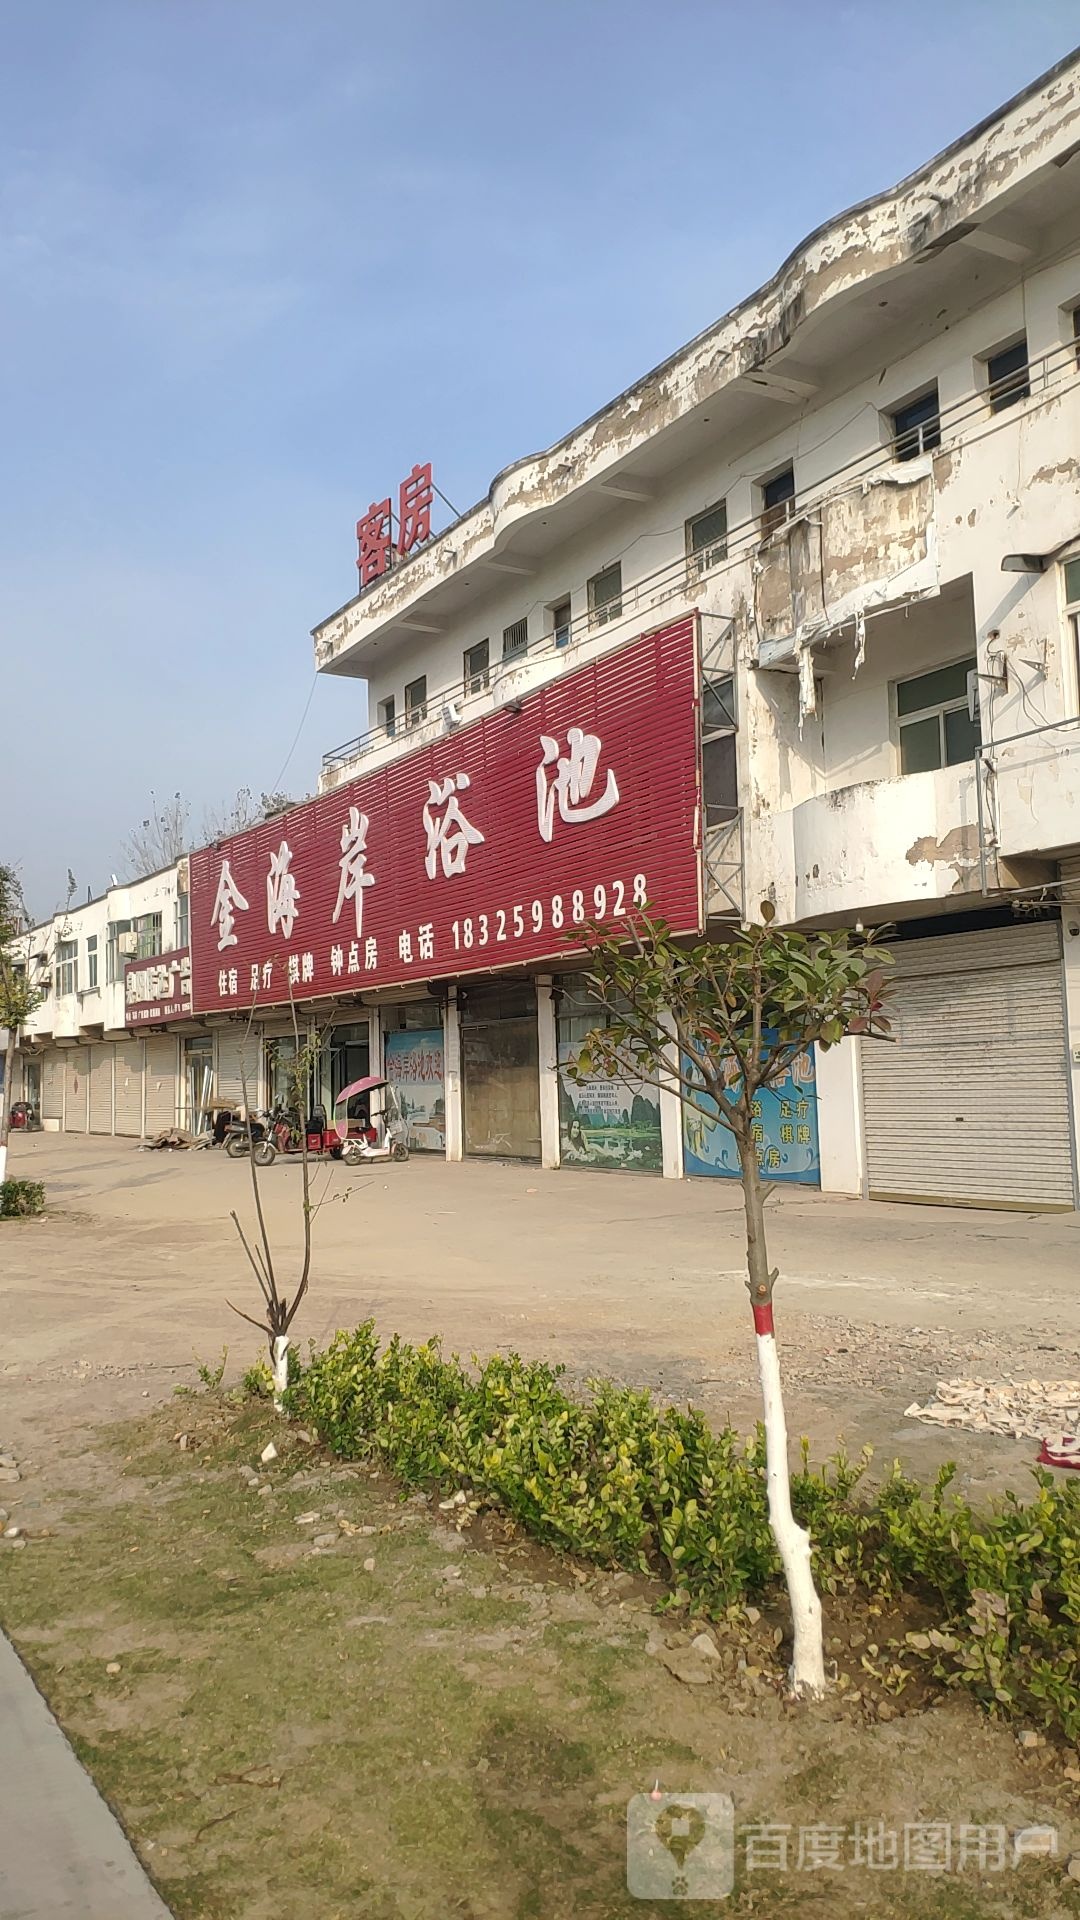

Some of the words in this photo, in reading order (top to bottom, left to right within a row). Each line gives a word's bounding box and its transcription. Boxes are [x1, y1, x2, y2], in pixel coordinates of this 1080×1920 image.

[356, 462, 433, 584] 客房
[210, 727, 620, 952] 金海岸浴池
[218, 967, 238, 997] 住宿
[250, 961, 273, 991] 足疗
[288, 952, 314, 984] 棋牌
[330, 936, 378, 976] 钟点房
[398, 922, 435, 963] 电话
[451, 873, 648, 951] 18325988928
[780, 1099, 810, 1119] 足疗
[780, 1124, 811, 1145] 棋牌
